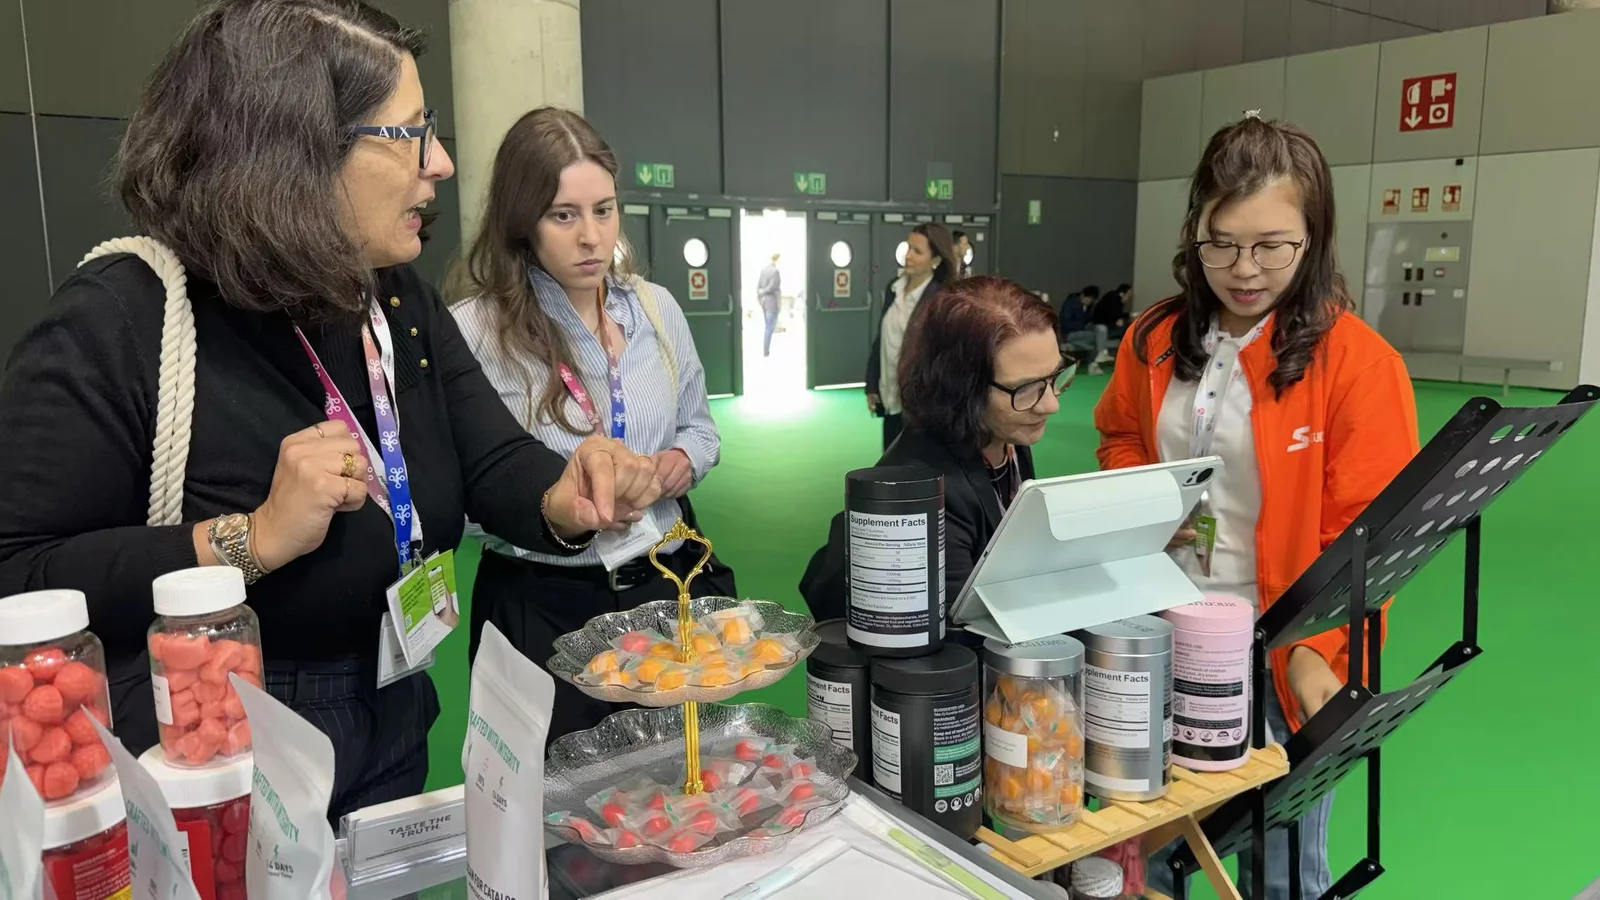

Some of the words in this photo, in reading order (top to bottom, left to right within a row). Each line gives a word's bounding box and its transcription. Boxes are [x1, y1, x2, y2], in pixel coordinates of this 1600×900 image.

[851, 514, 899, 527] Supplement
[901, 518, 926, 527] Facts
[1124, 674, 1149, 683] Facts
[828, 685, 850, 694] Facts
[880, 712, 899, 725] Facts
[389, 821, 426, 835] TASTE
[430, 814, 452, 824] THE
[274, 861, 294, 874] DAYS
